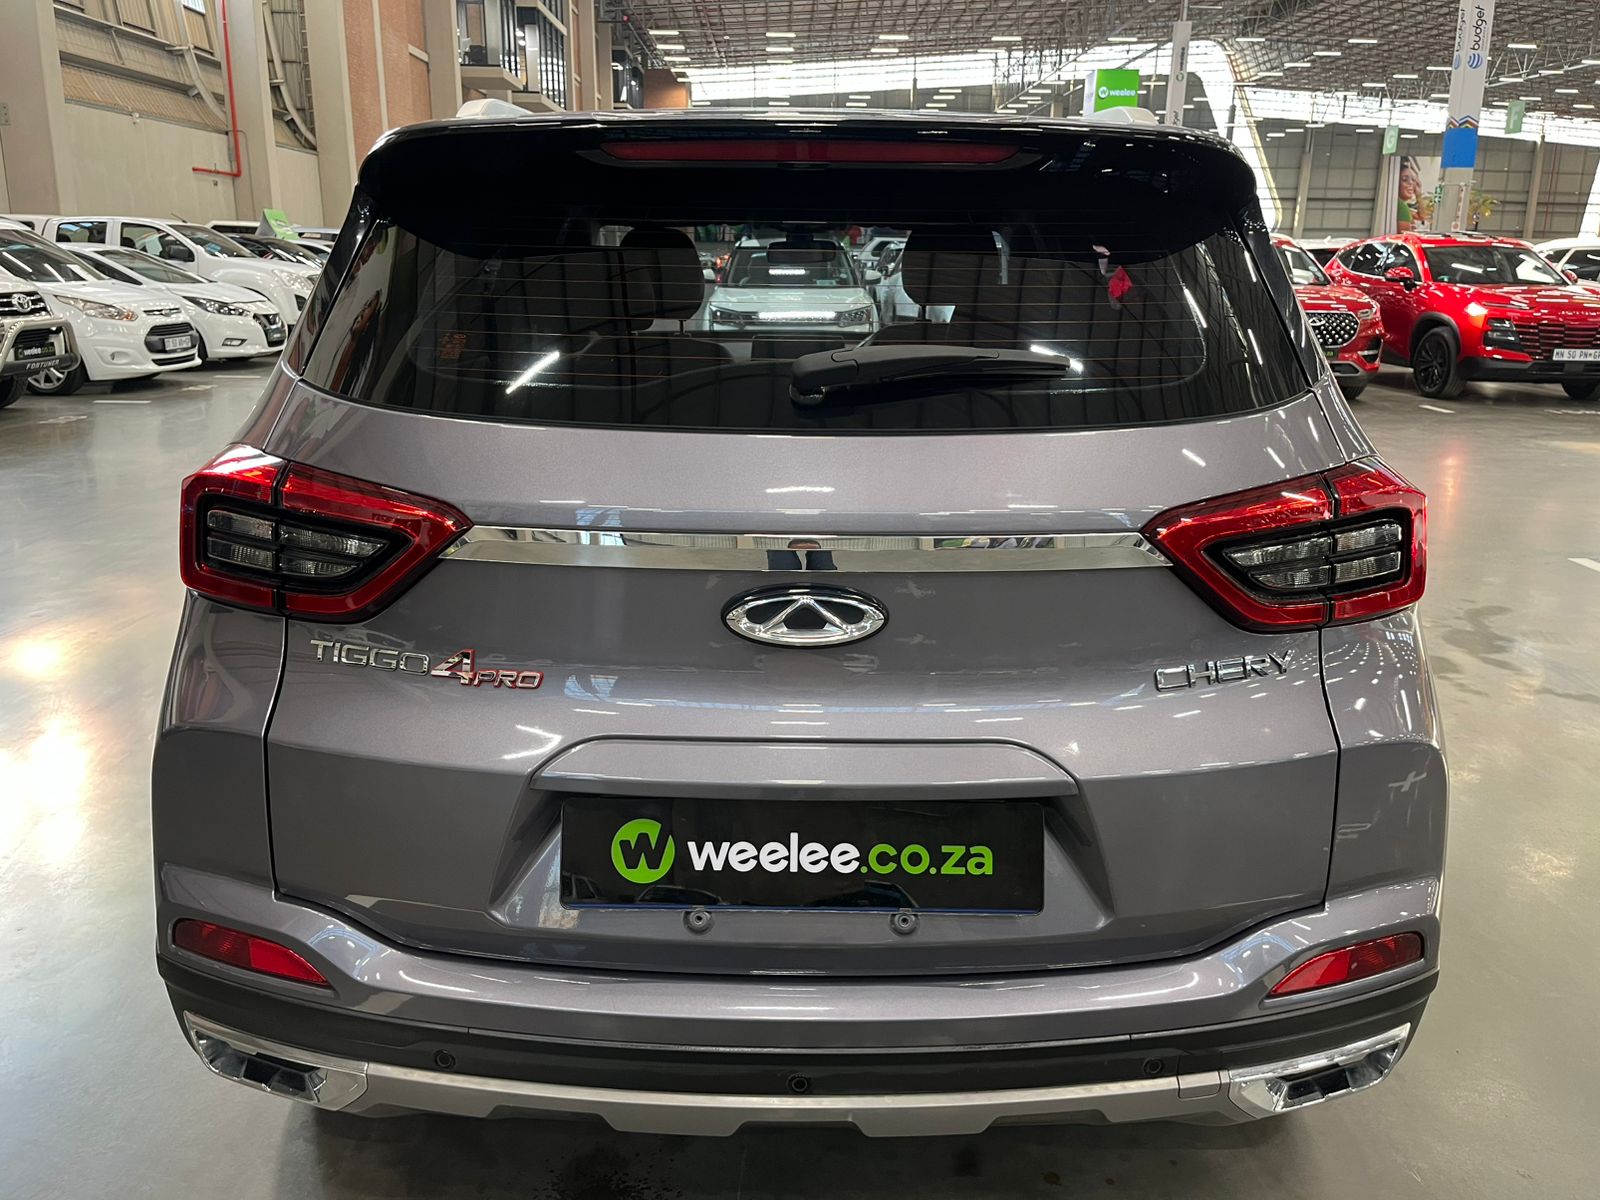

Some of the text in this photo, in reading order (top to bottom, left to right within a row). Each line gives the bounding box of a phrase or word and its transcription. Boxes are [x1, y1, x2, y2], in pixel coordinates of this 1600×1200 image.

[1470, 5, 1488, 51] budget
[1109, 87, 1136, 96] weelee
[1383, 130, 1396, 149] G
[25, 359, 60, 370] FORTUNER
[310, 639, 430, 676] TIGGO
[1154, 649, 1297, 692] CHERY
[687, 832, 994, 876] weelee.co.za
